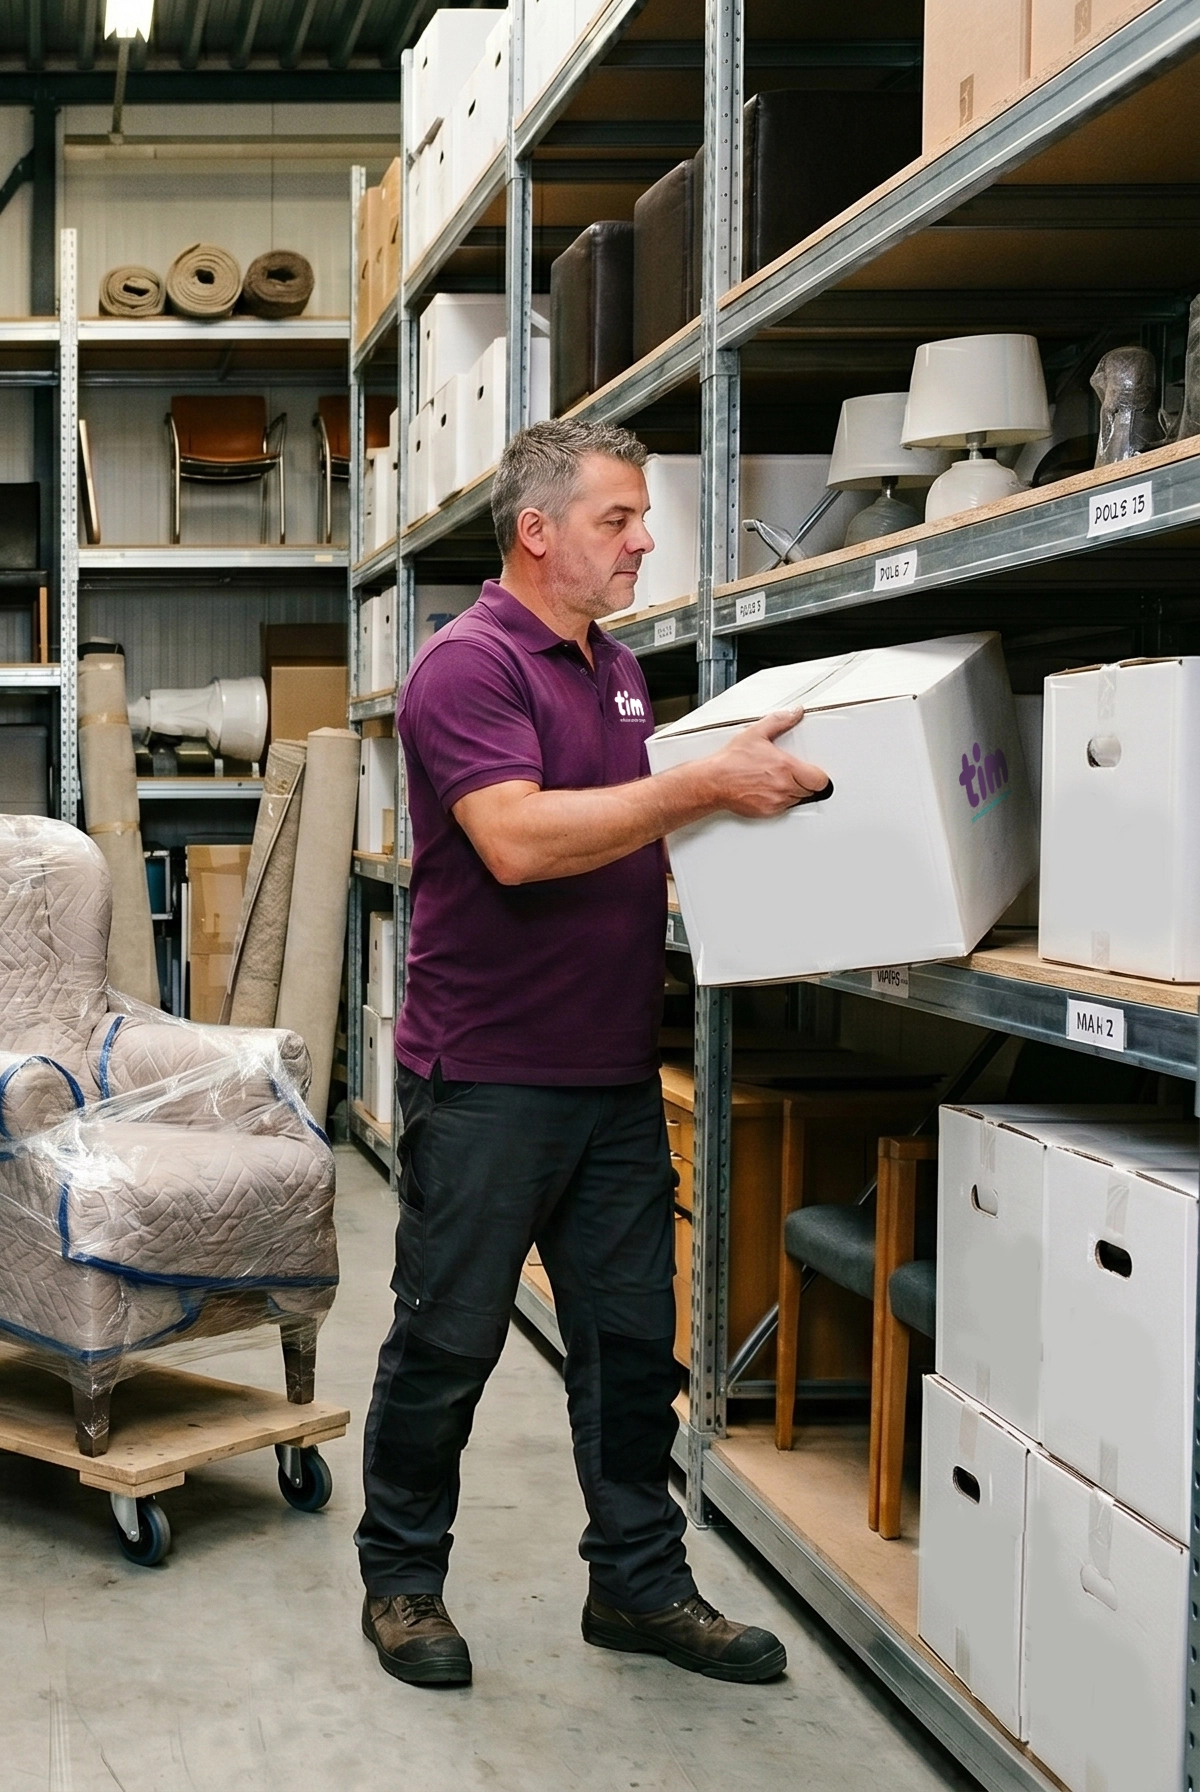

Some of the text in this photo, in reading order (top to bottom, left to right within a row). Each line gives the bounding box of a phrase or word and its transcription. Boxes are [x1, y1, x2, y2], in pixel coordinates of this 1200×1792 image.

[1132, 494, 1145, 515] 15
[903, 561, 910, 576] 7
[614, 690, 645, 716] tim
[959, 742, 1009, 808] tim
[1106, 1018, 1114, 1038] 2
